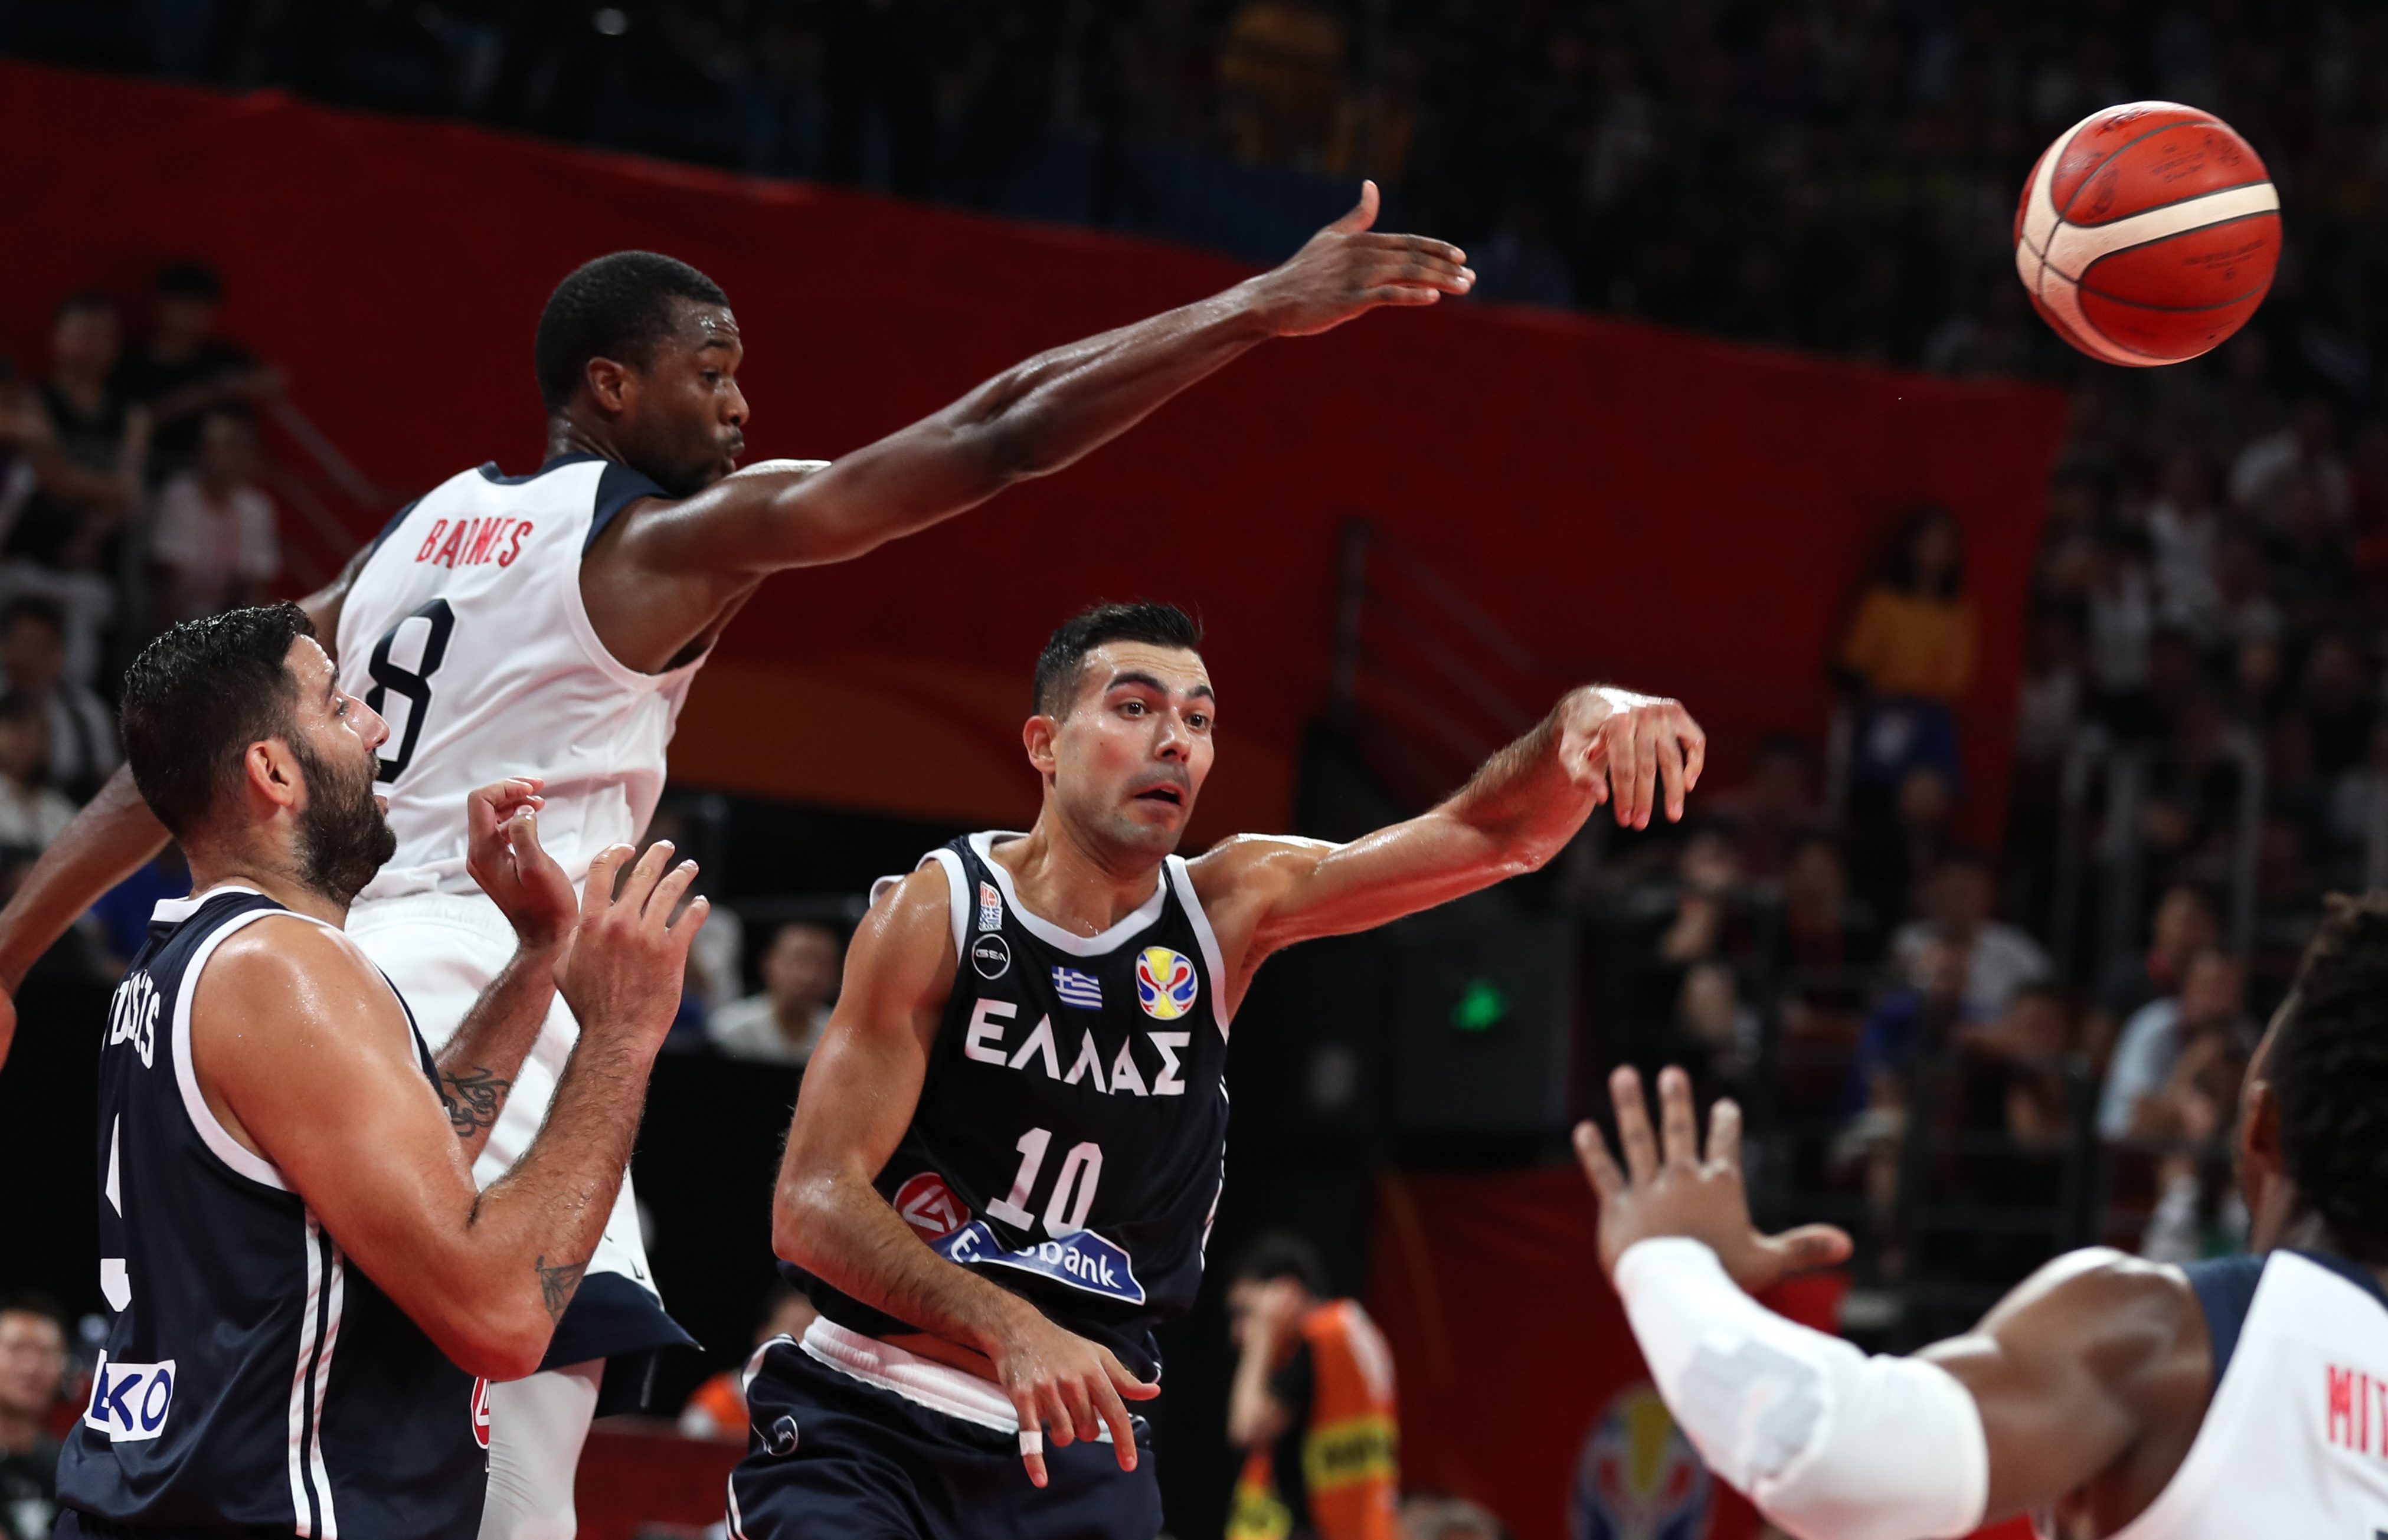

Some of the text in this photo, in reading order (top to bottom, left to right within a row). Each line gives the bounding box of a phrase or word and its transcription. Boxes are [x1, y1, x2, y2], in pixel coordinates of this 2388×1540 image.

[365, 598, 456, 784] 8
[964, 997, 1191, 1096] ΕΛΛΑΣ
[985, 1127, 1104, 1240] 10
